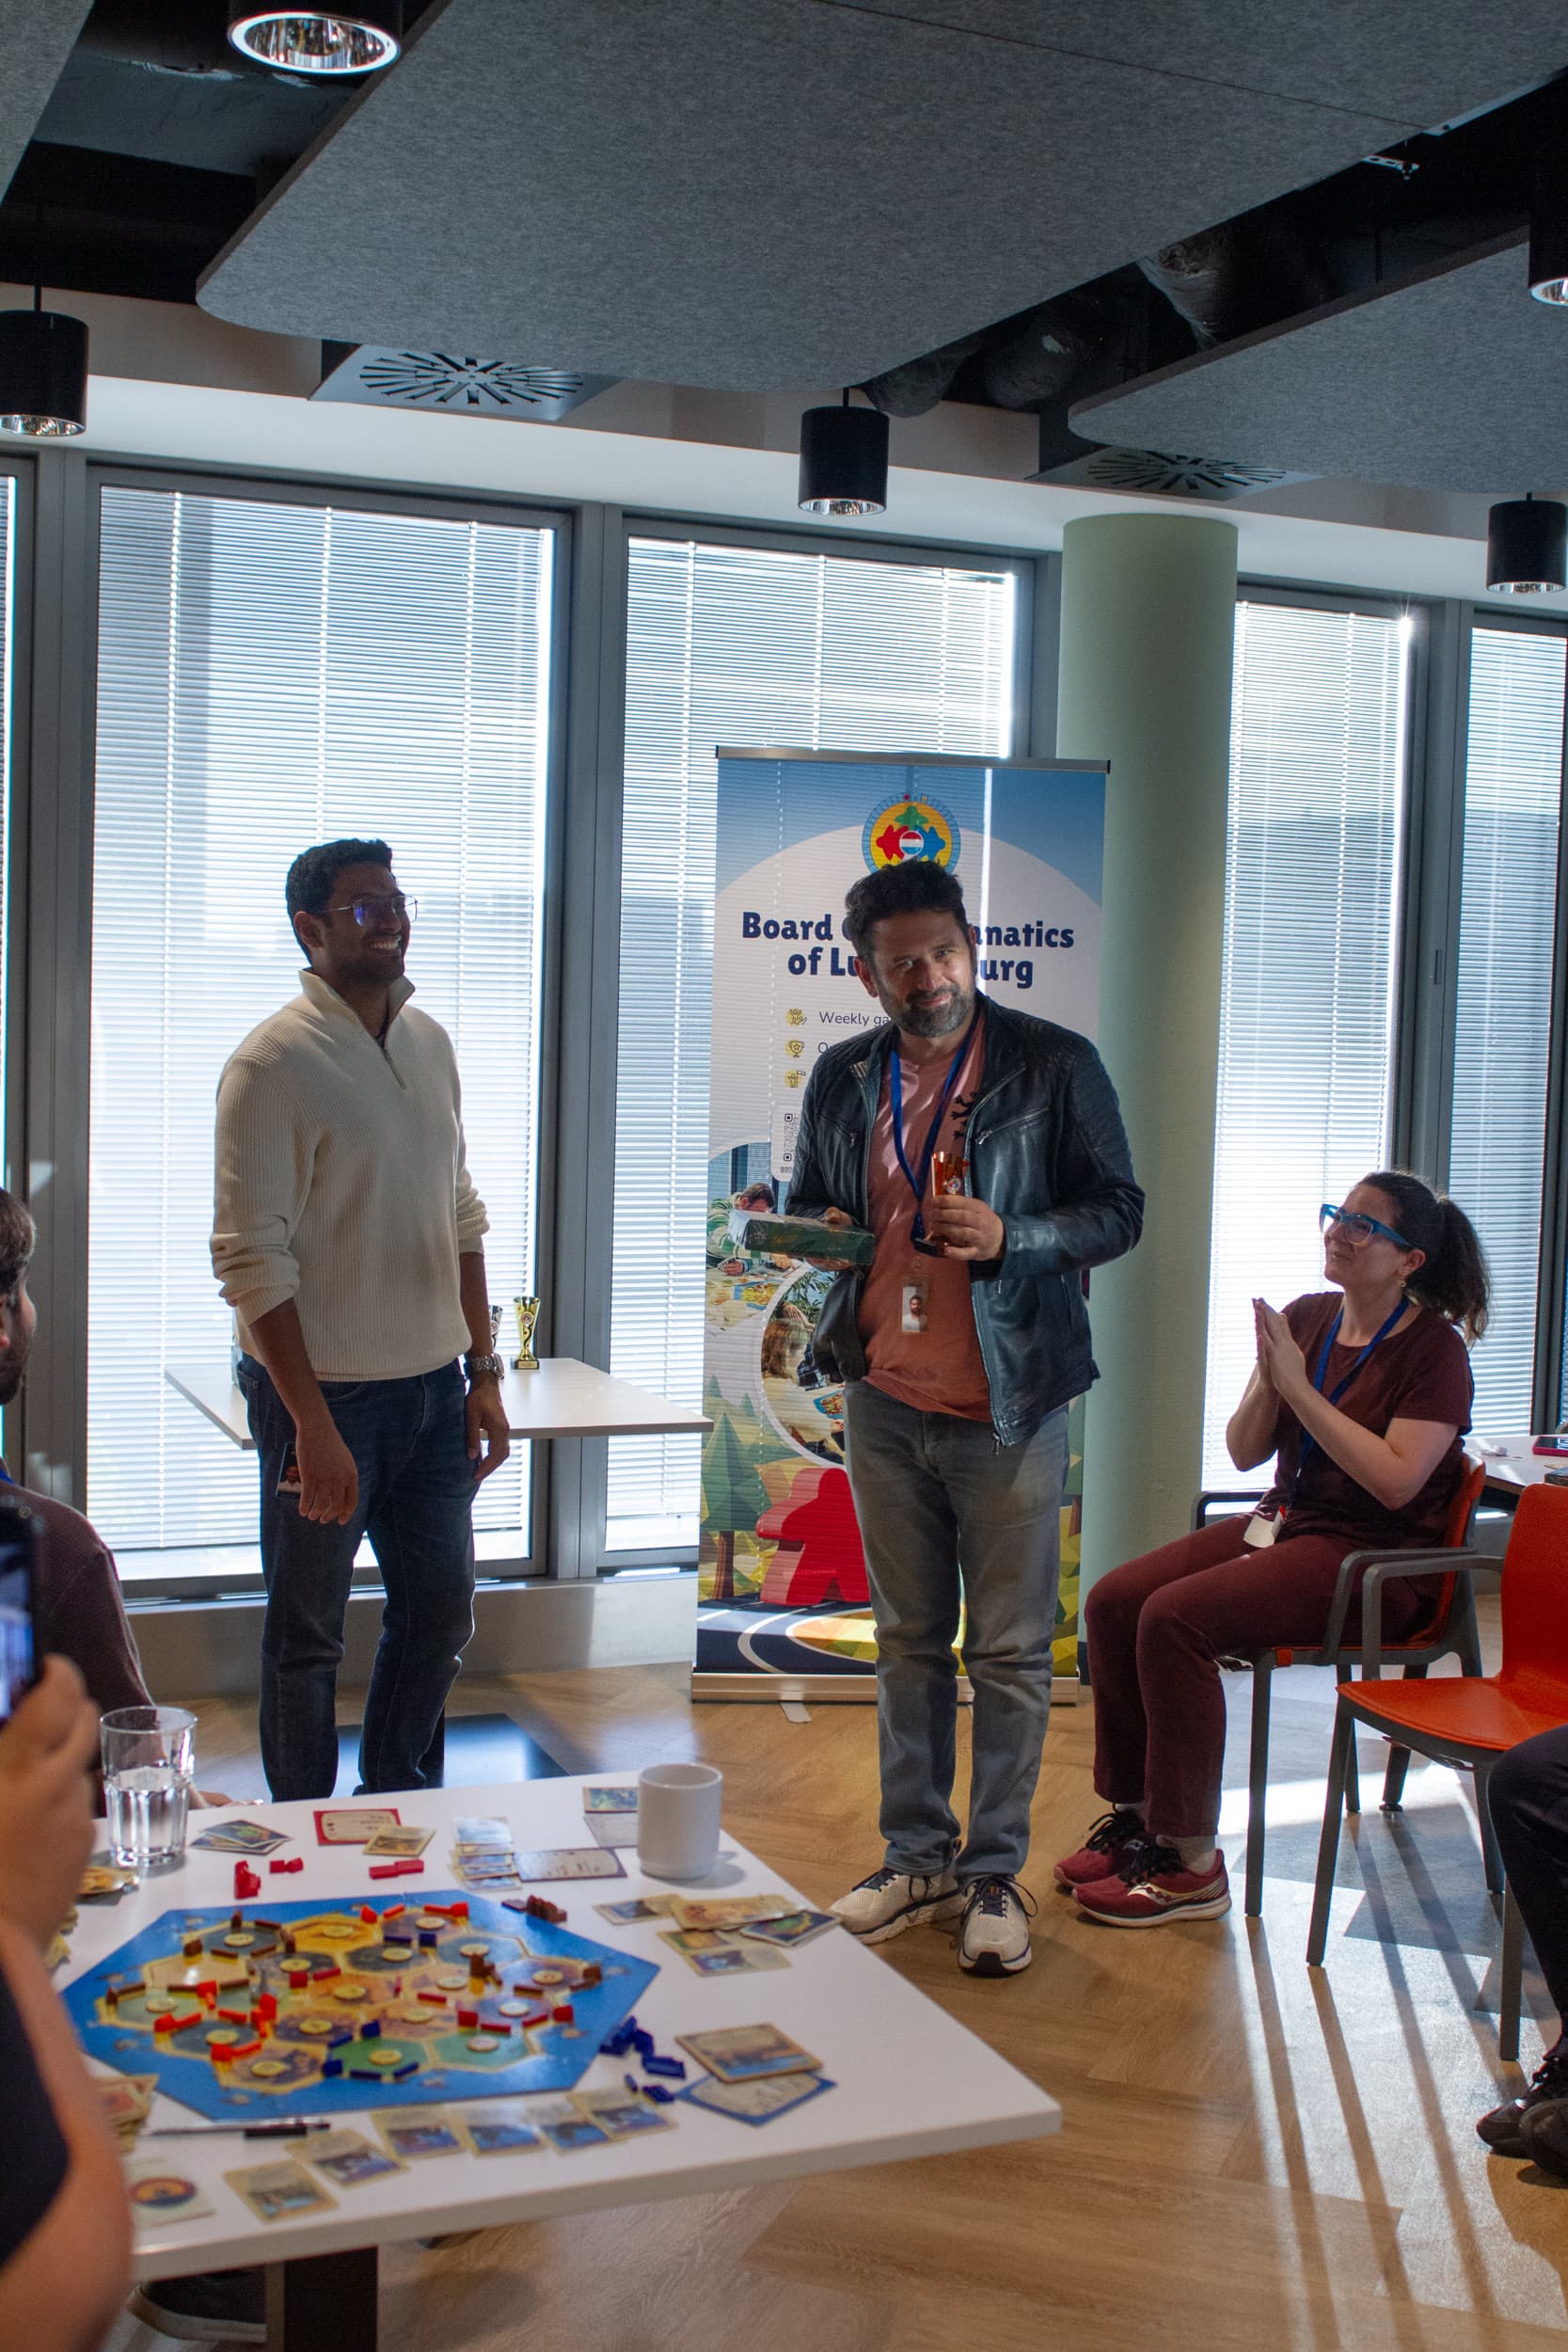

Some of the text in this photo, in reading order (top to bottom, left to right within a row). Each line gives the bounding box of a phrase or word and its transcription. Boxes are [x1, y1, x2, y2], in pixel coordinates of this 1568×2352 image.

[742, 912, 833, 941] Board
[787, 946, 824, 976] of
[819, 1011, 869, 1027] Weekly
